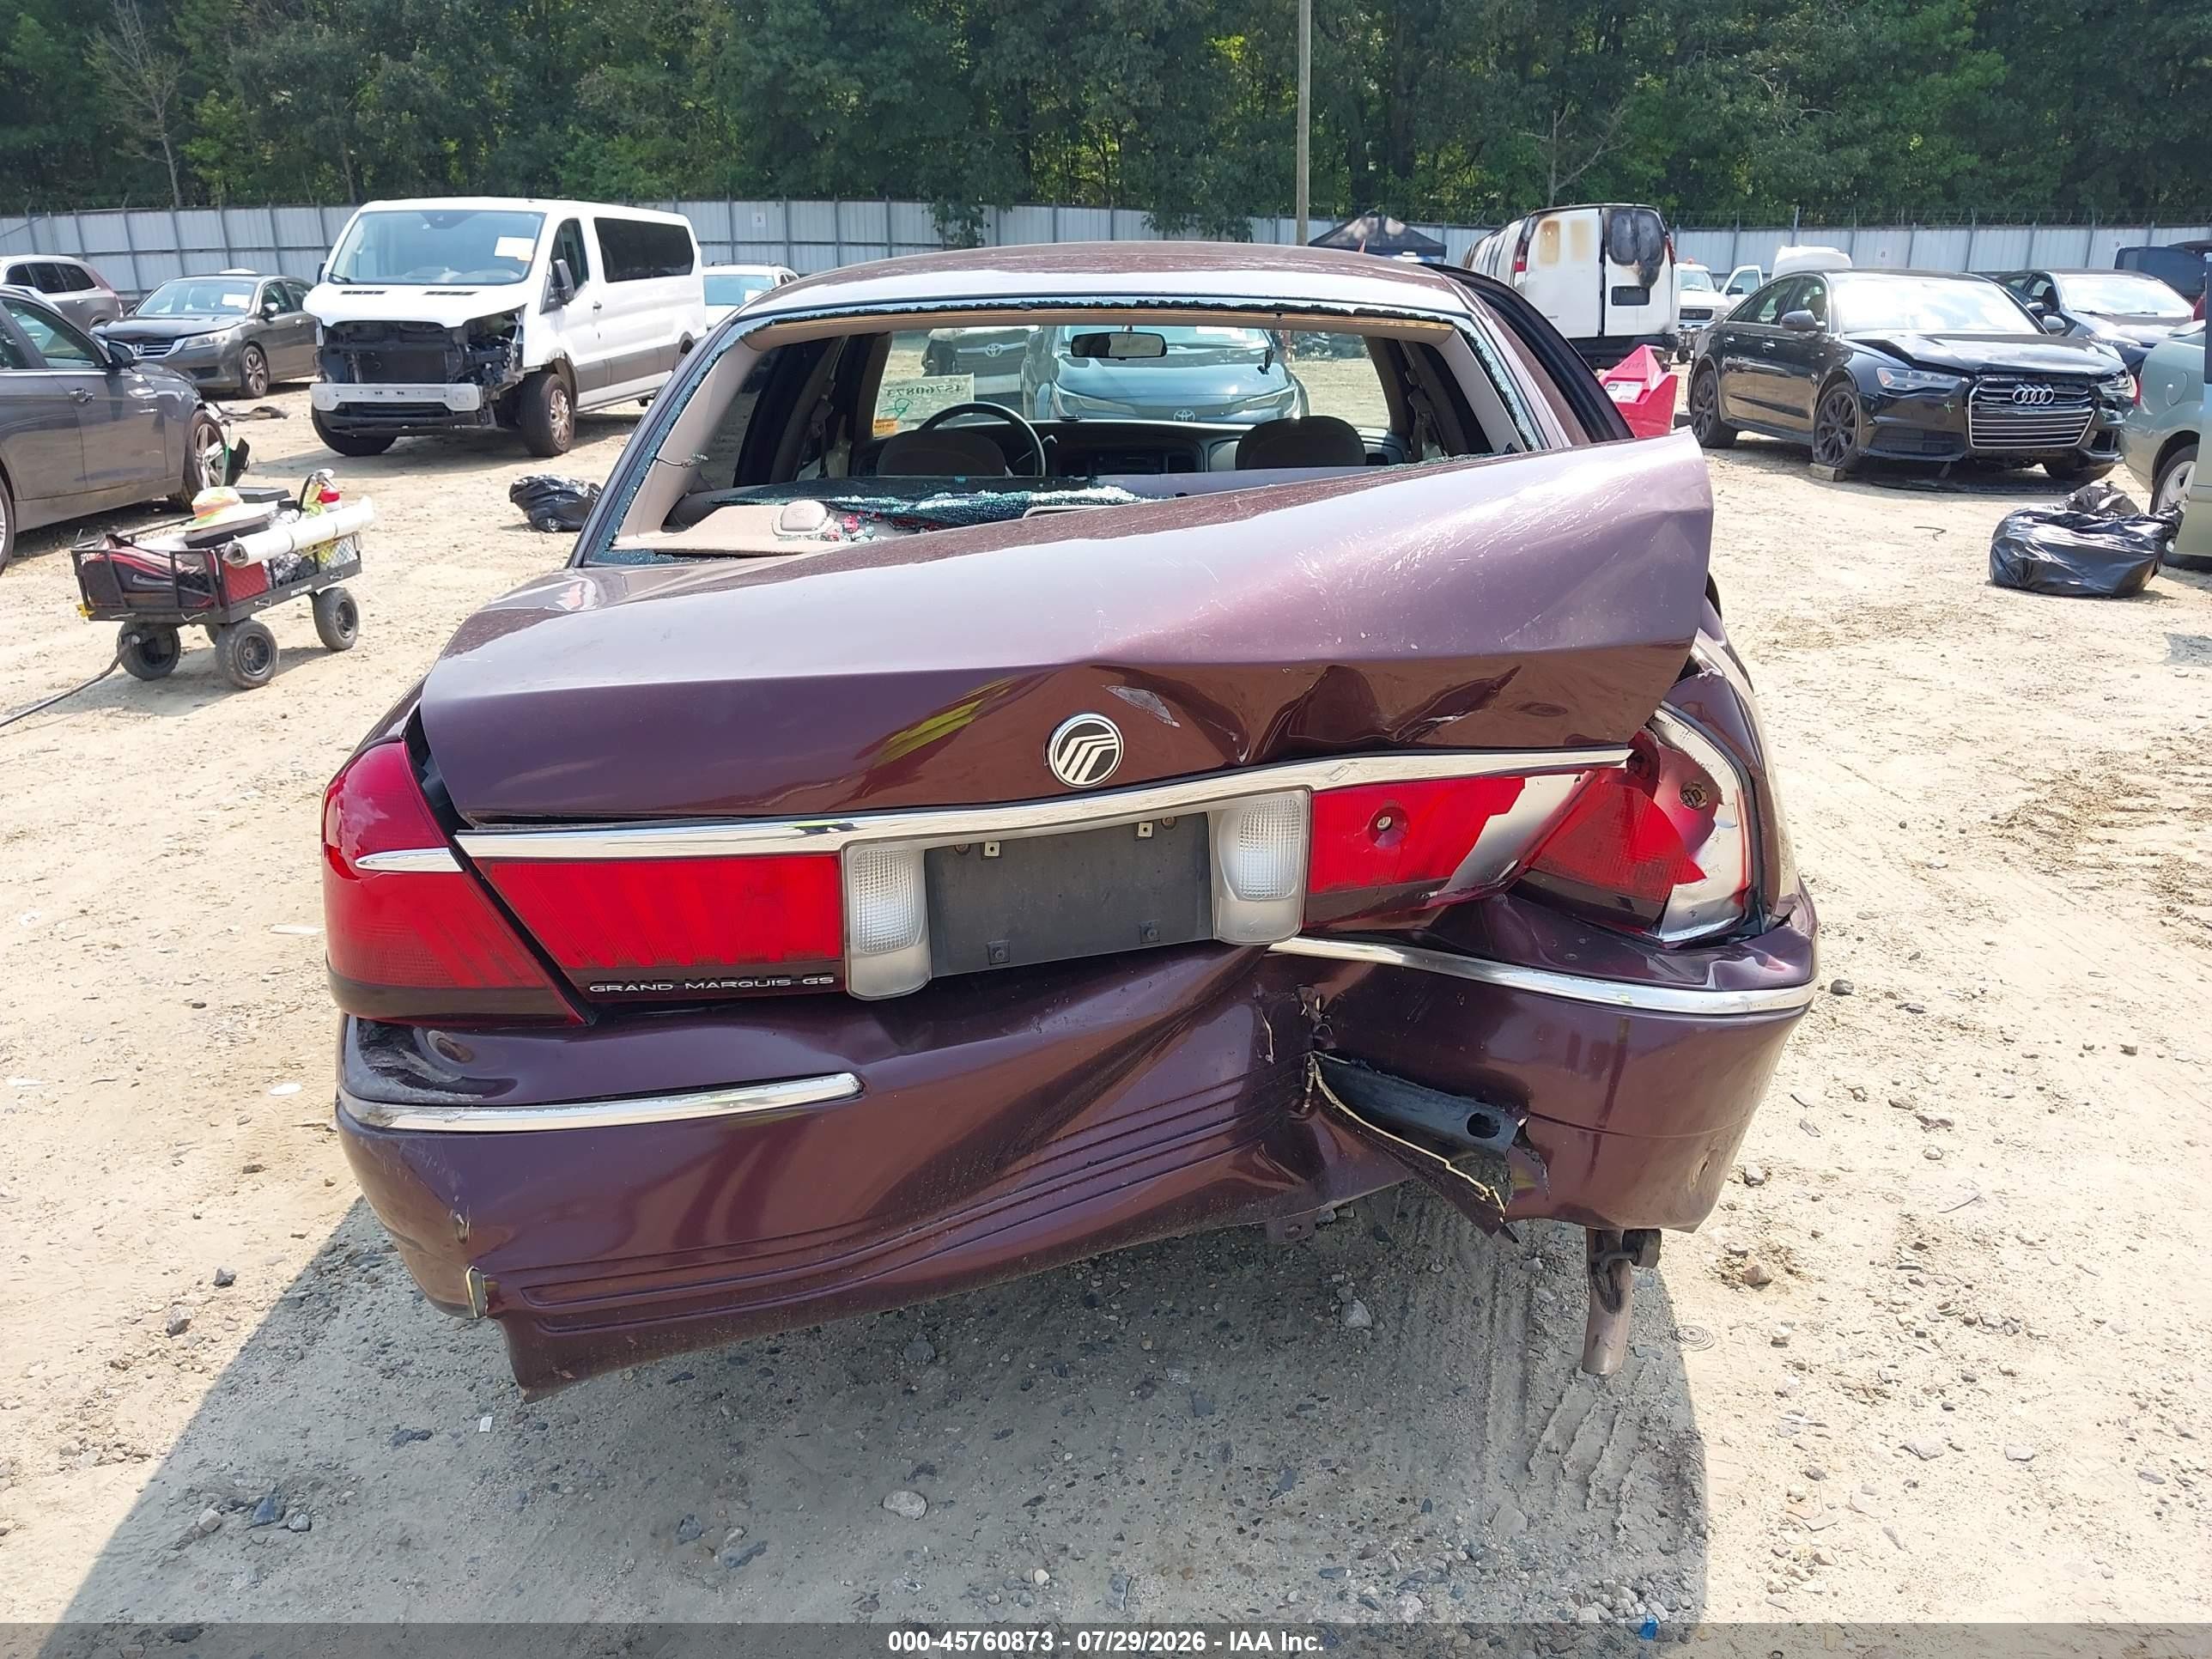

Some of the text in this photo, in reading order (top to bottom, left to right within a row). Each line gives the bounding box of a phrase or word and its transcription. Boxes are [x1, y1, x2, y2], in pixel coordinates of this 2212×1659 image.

[589, 975, 835, 993] GRAND MARQUIS GS
